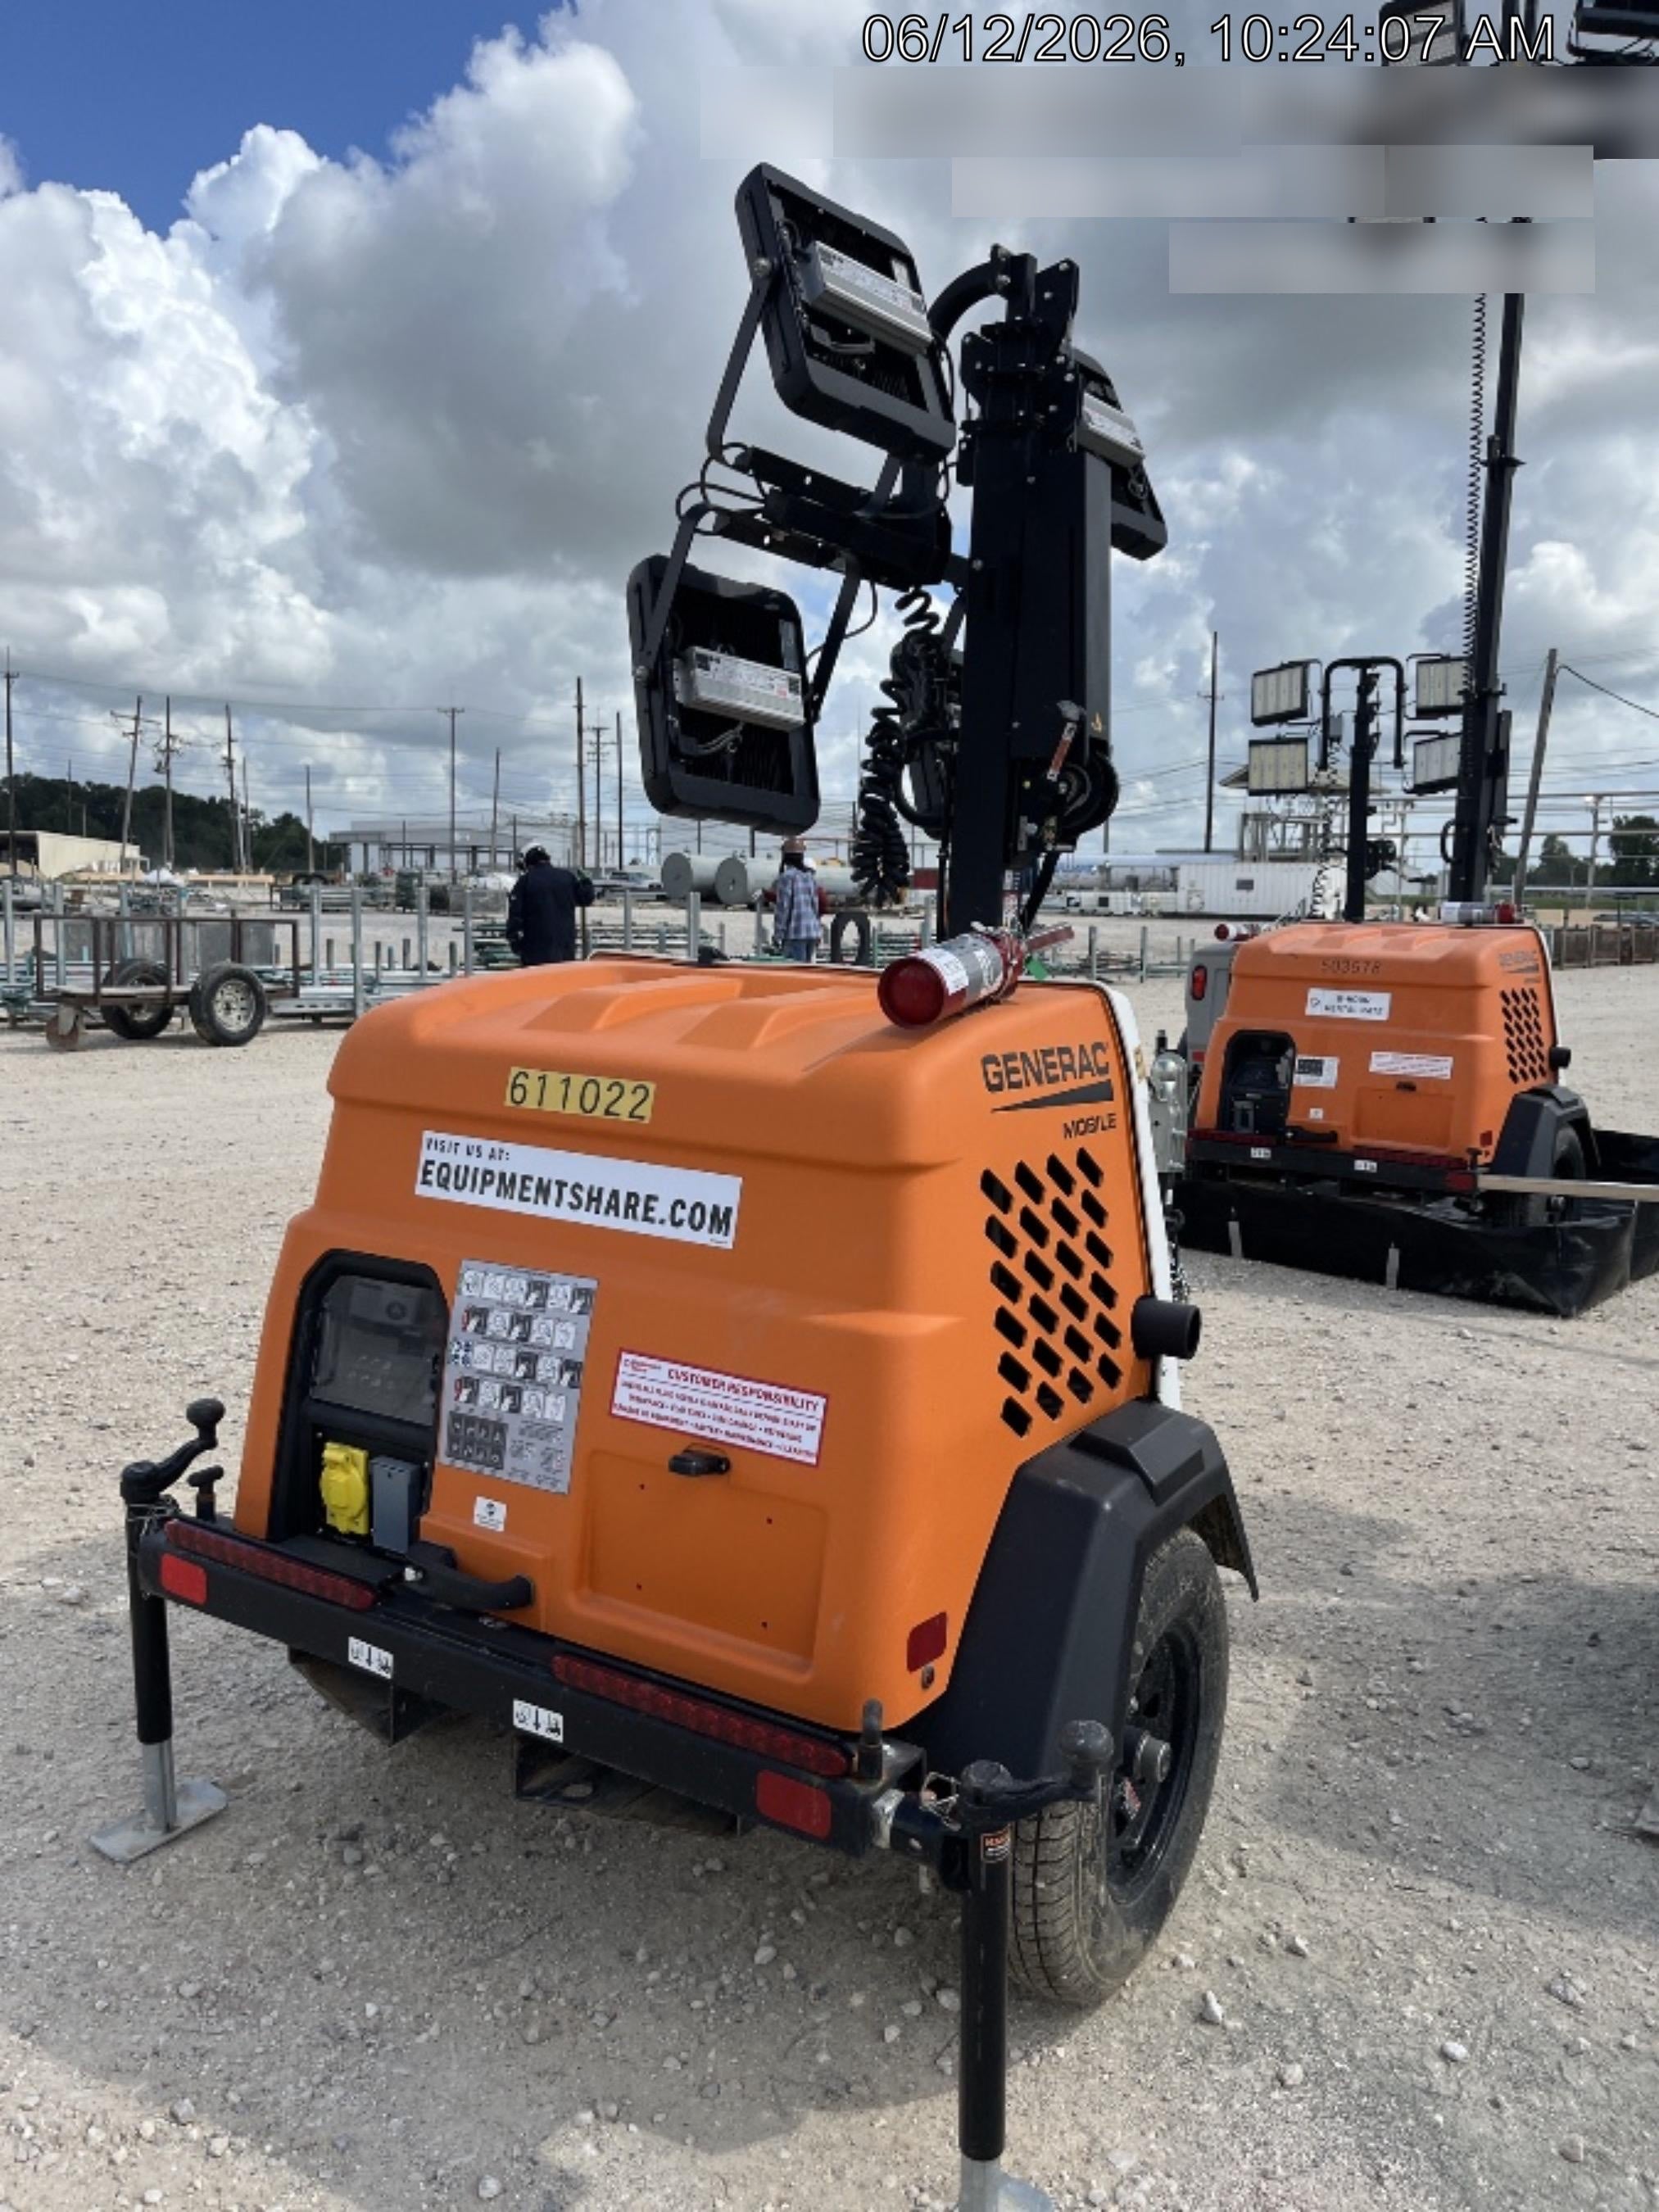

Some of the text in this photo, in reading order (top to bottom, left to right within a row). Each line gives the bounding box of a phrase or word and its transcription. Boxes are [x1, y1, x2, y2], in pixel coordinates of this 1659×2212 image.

[981, 1041, 1109, 1093] GENERAC
[509, 1070, 652, 1122] 611022
[1063, 1113, 1117, 1140] MOBILE
[426, 1137, 510, 1162] VISIT US AT:
[419, 1159, 734, 1238] EQUIPMENTSHARE.COM
[667, 1367, 726, 1393] CUSTOMER
